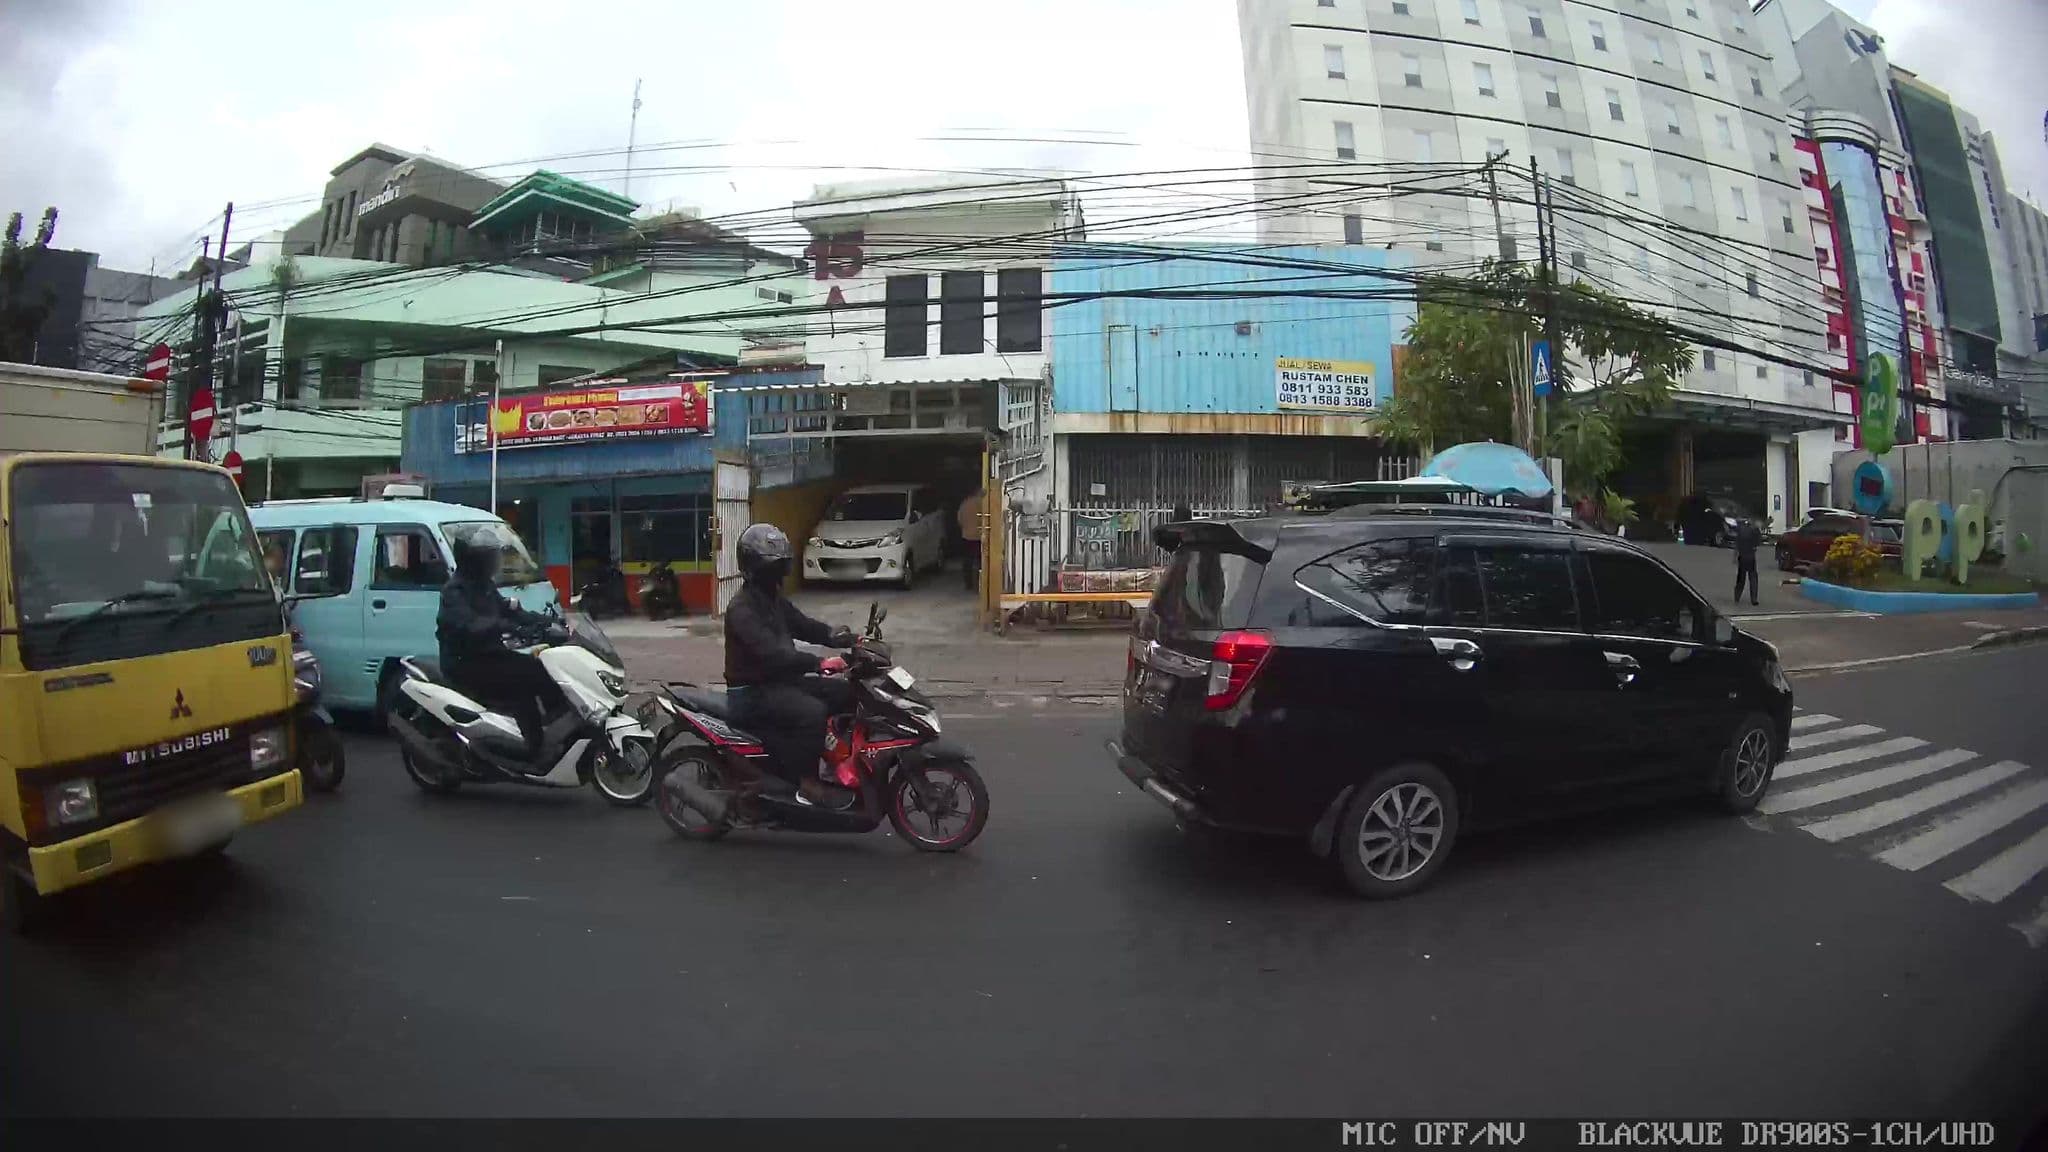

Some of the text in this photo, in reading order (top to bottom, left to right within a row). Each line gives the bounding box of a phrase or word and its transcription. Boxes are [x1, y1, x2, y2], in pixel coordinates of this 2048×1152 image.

[1282, 371, 1369, 384] RUSTAM CHEN
[1281, 382, 1369, 396] 0811 933 583
[1279, 392, 1373, 407] 0813 1588 3388
[125, 727, 230, 765] MITSUBISHI
